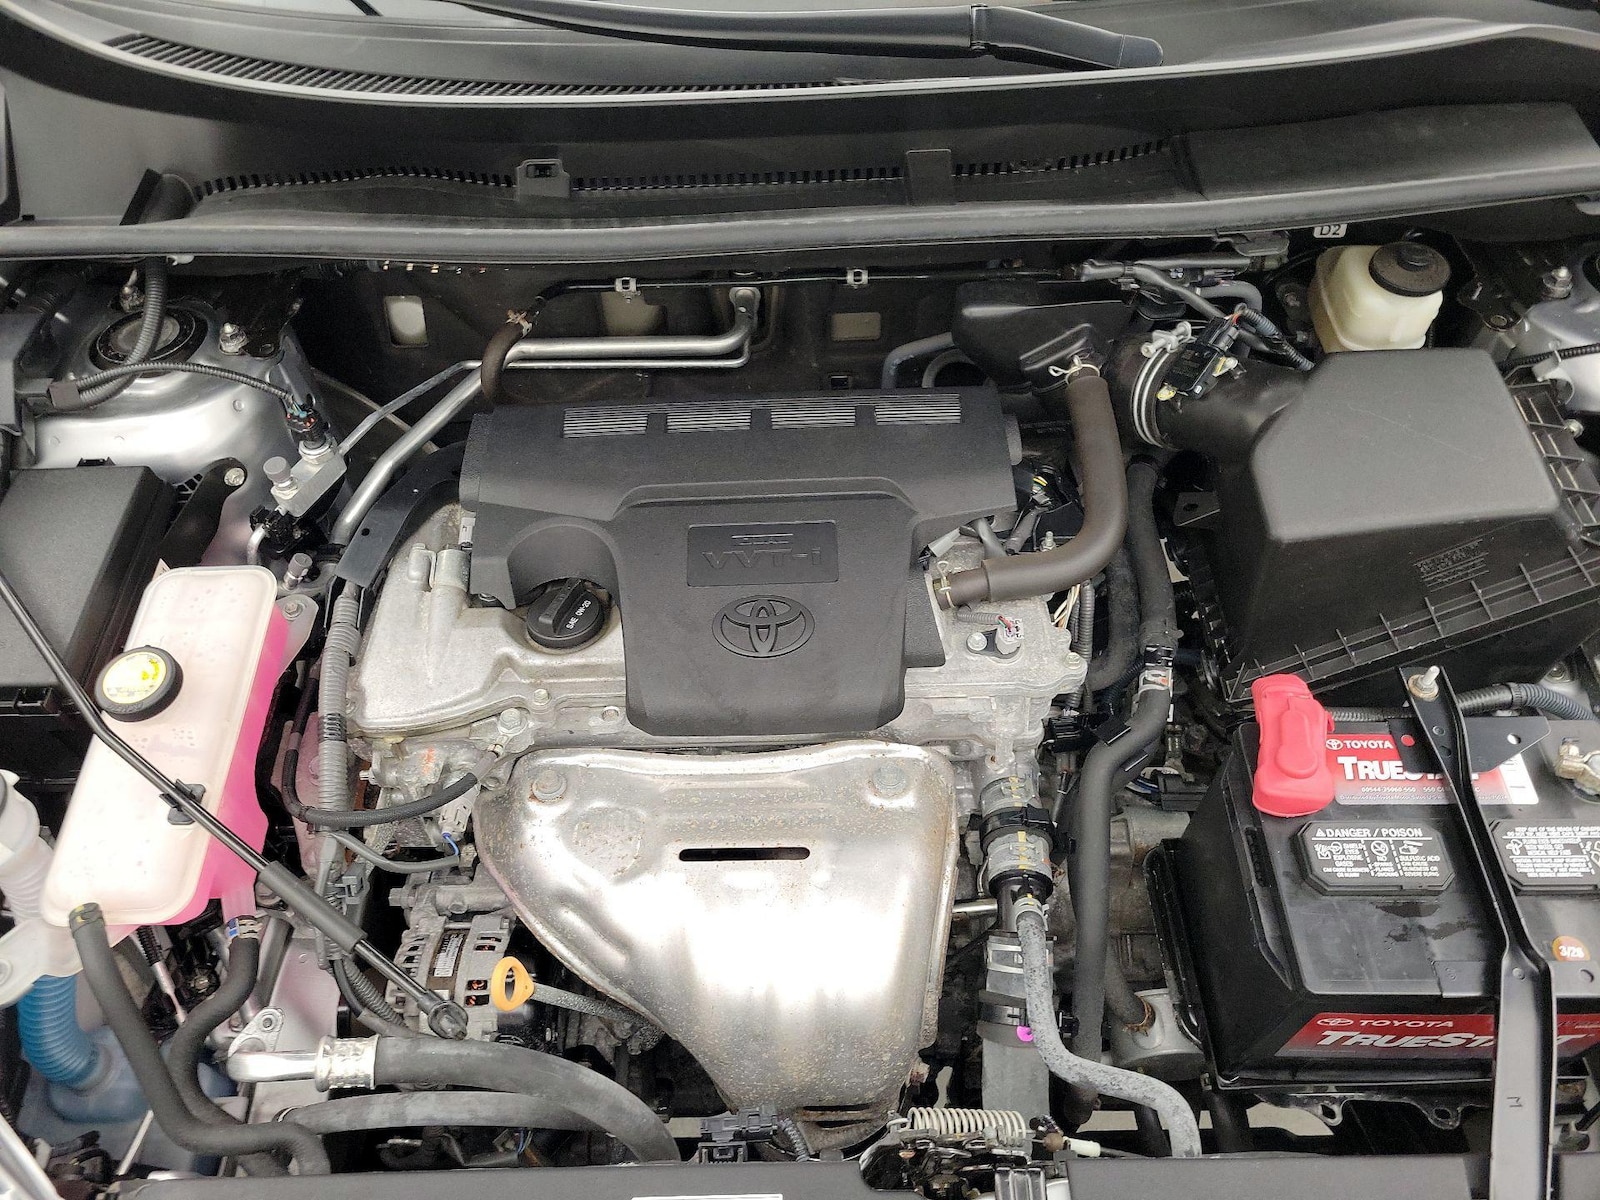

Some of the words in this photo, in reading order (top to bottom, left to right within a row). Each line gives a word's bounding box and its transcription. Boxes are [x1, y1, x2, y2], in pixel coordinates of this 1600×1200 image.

[1320, 224, 1341, 235] D2
[565, 617, 579, 629] SAE
[575, 600, 591, 616] 0W-20
[1343, 740, 1393, 749] TOYOTA
[1325, 828, 1371, 837] DANGER
[1373, 828, 1379, 837] /
[1381, 828, 1423, 837] POISON
[1359, 1019, 1454, 1028] TOYOTA
